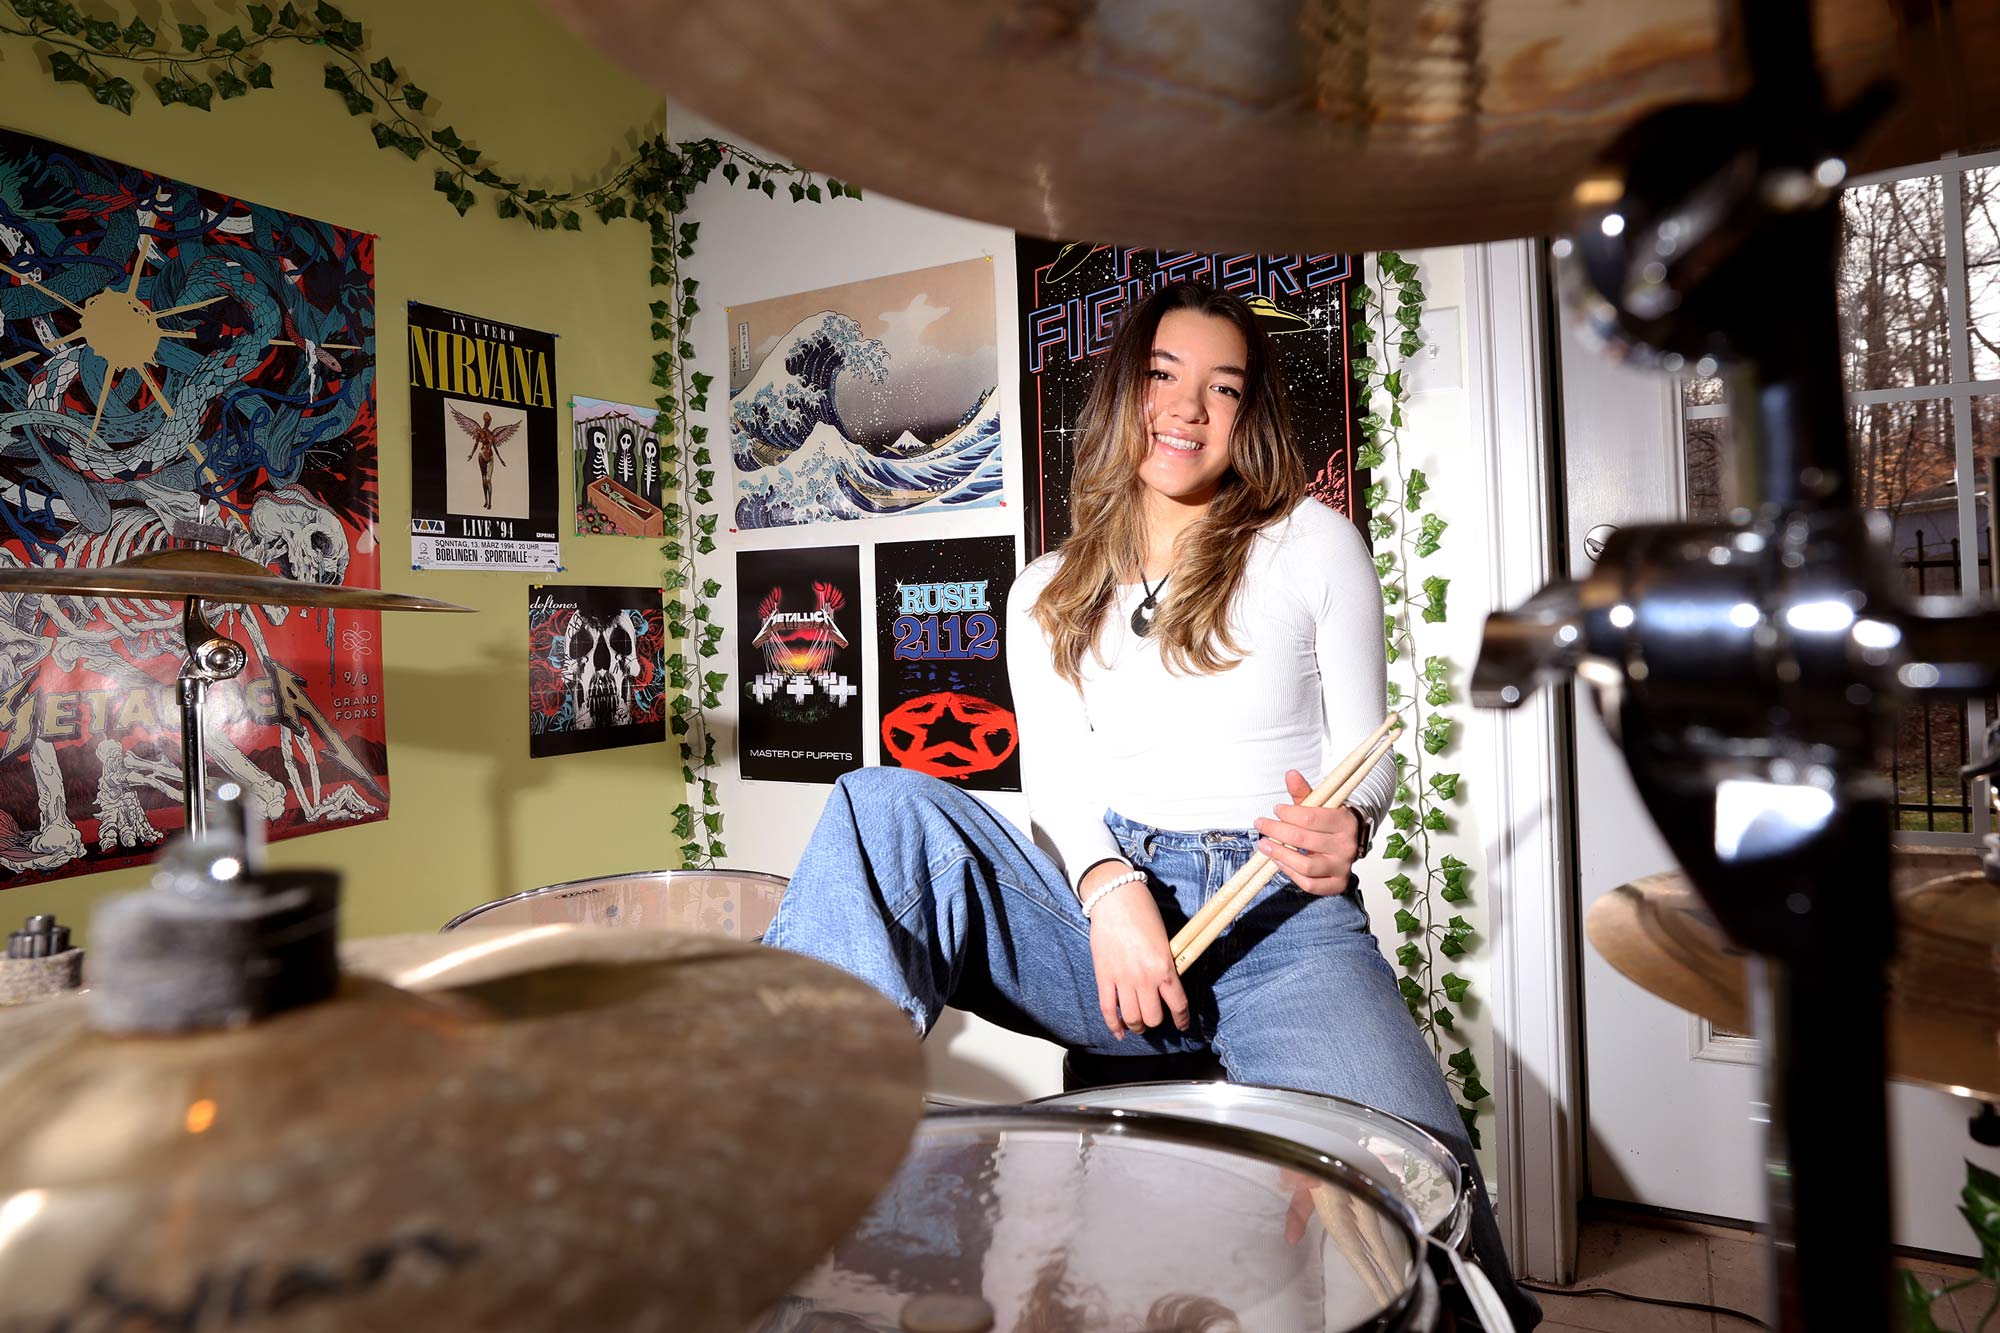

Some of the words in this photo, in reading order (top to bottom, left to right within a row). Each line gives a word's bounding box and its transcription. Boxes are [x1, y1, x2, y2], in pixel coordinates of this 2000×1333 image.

[452, 317, 466, 332] IN
[474, 321, 515, 342] UTERO
[408, 324, 554, 409] NIRVANA
[463, 518, 492, 538] LIVE
[484, 549, 528, 563] SPORTHALLE
[526, 543, 540, 551] UHR
[529, 594, 578, 613] deftones
[899, 580, 990, 614] RUSH
[751, 608, 849, 645] METALLICA
[893, 613, 999, 660] 2112
[344, 671, 369, 686] 9/8
[333, 695, 379, 708] GRAND
[335, 708, 378, 721] FORKS
[750, 749, 790, 758] MASTER
[791, 750, 805, 759] OF
[806, 751, 853, 761] PUPPETS
